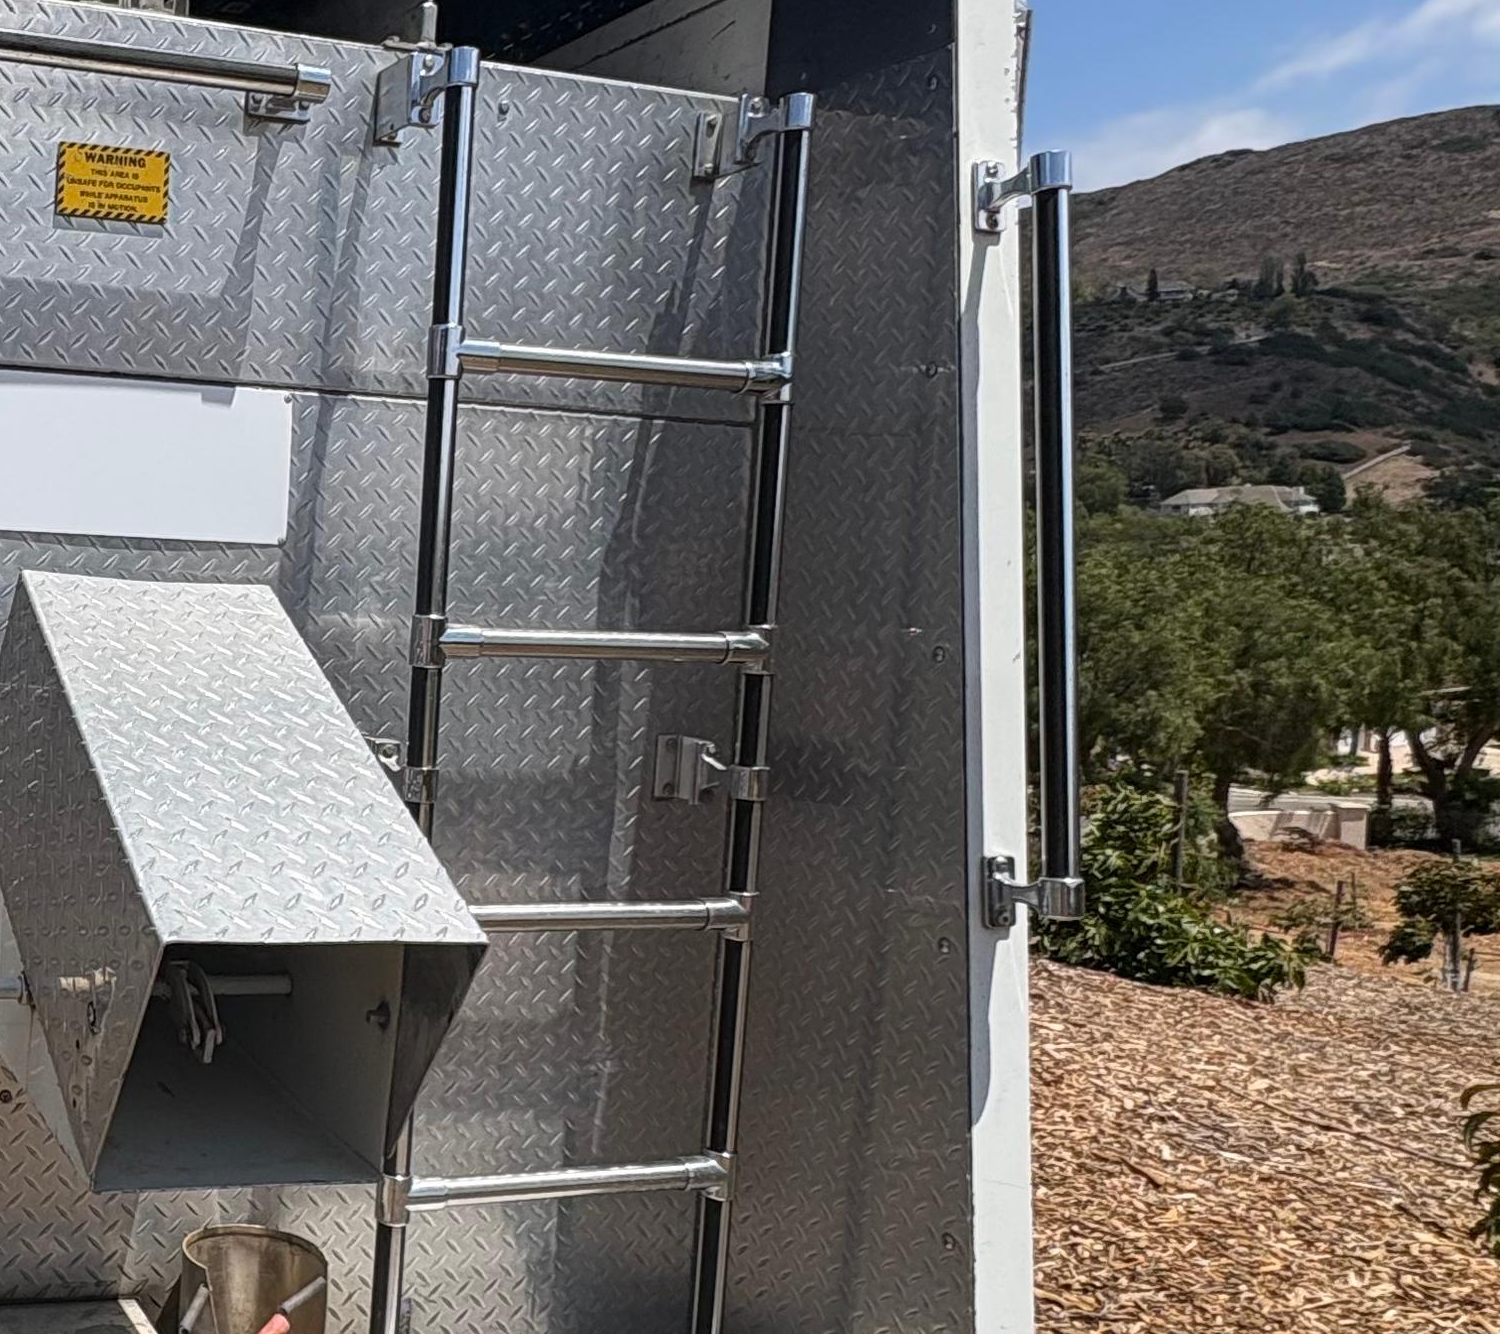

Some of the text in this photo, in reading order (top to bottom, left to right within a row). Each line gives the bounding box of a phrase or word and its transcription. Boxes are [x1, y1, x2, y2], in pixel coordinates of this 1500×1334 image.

[85, 152, 146, 168] WARNING
[91, 169, 108, 177] THIS
[110, 171, 130, 179] AREA
[67, 177, 161, 193] UNSAFE FOR OCCUPANTS
[80, 191, 149, 203] WHILE APPARATUS
